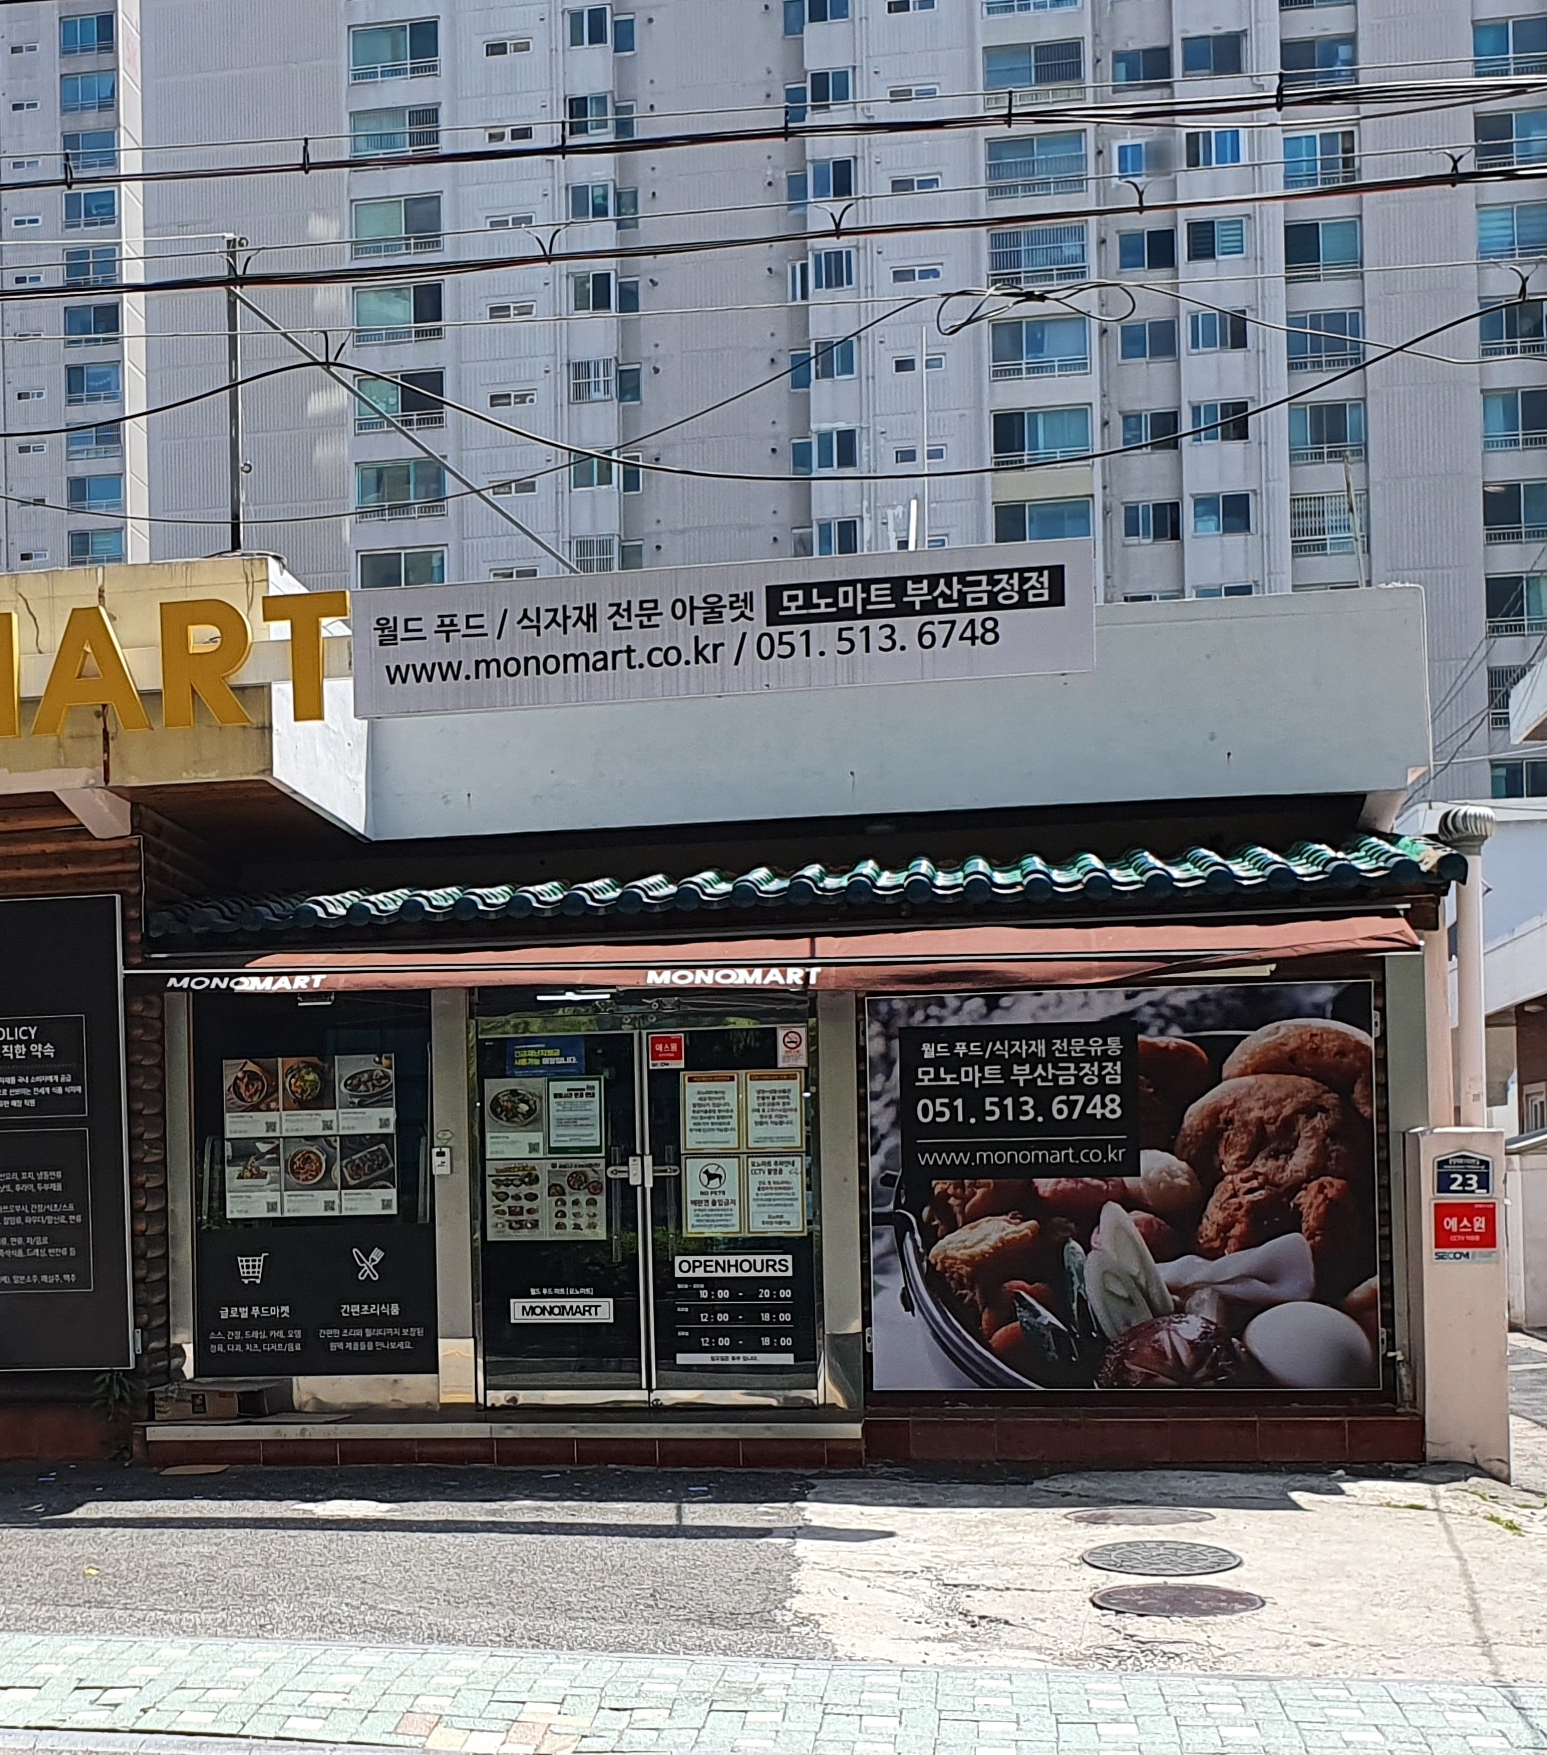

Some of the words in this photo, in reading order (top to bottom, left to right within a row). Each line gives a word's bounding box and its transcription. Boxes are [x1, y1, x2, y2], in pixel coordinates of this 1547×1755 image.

[373, 616, 427, 647] 월드
[433, 612, 489, 643] 푸드
[516, 602, 597, 638] 식자재
[606, 598, 662, 632] 전문
[671, 590, 755, 627] 아울렛
[777, 582, 896, 616] 모노마트
[902, 569, 1051, 610] 부산금정점
[385, 635, 725, 685] www.monomart.co.kr
[918, 617, 1000, 649] 6748
[167, 975, 327, 991] MONOMART
[646, 967, 821, 986] MONOMART
[30, 1042, 55, 1059] 약속
[655, 1043, 677, 1054] 에스원
[921, 1041, 951, 1060] 월드
[1051, 1036, 1123, 1058] 전문유통
[915, 1063, 1005, 1088] 모노마트
[1010, 1060, 1122, 1087] 부산금정점
[1052, 1094, 1122, 1120] 6748
[918, 1144, 1126, 1167] www.monomart.co.kr
[1449, 1173, 1478, 1190] 23
[1443, 1216, 1486, 1233] 에스원
[1434, 1251, 1470, 1260] SECOM
[678, 1258, 789, 1274] OPENHOURS
[219, 1306, 249, 1319] 글로벌
[250, 1304, 290, 1319] 푸드마켓
[340, 1302, 400, 1317] 간편조리식품
[522, 1304, 602, 1317] MONOMART
